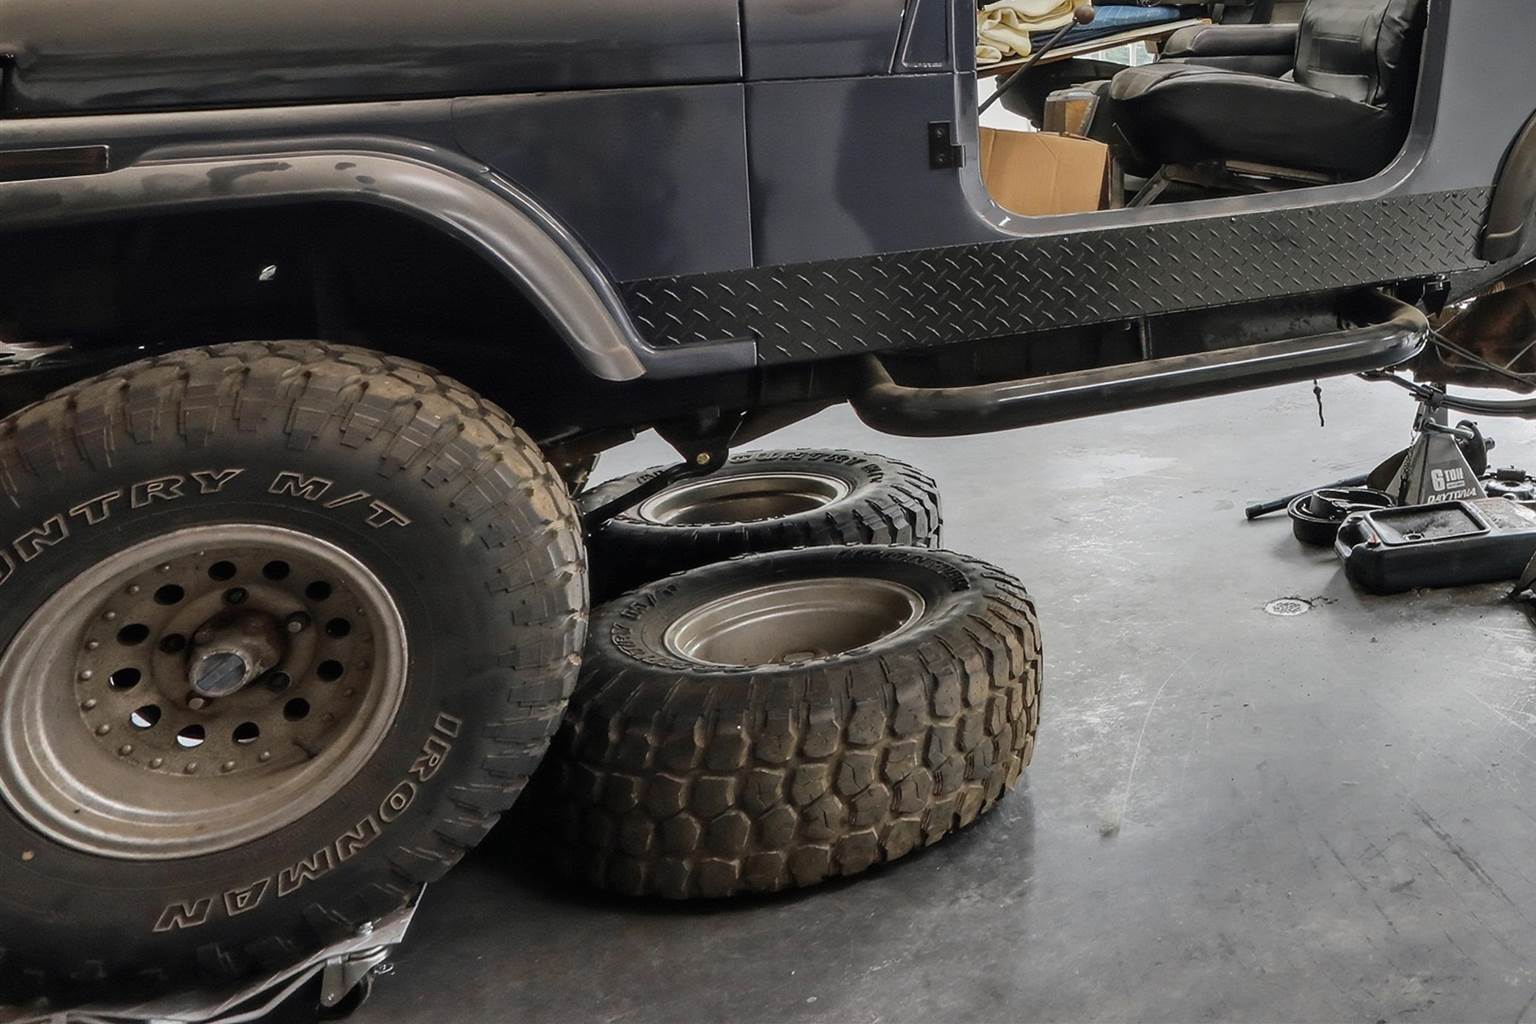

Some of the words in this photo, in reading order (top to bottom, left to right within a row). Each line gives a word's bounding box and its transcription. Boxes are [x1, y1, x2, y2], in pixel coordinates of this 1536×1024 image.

[729, 451, 867, 466] OUNTRY
[1431, 469, 1446, 492] 6
[1444, 467, 1465, 482] TON
[268, 471, 411, 529] M/T
[1427, 487, 1478, 505] DAYTONA
[152, 711, 463, 933] IRONMAN
